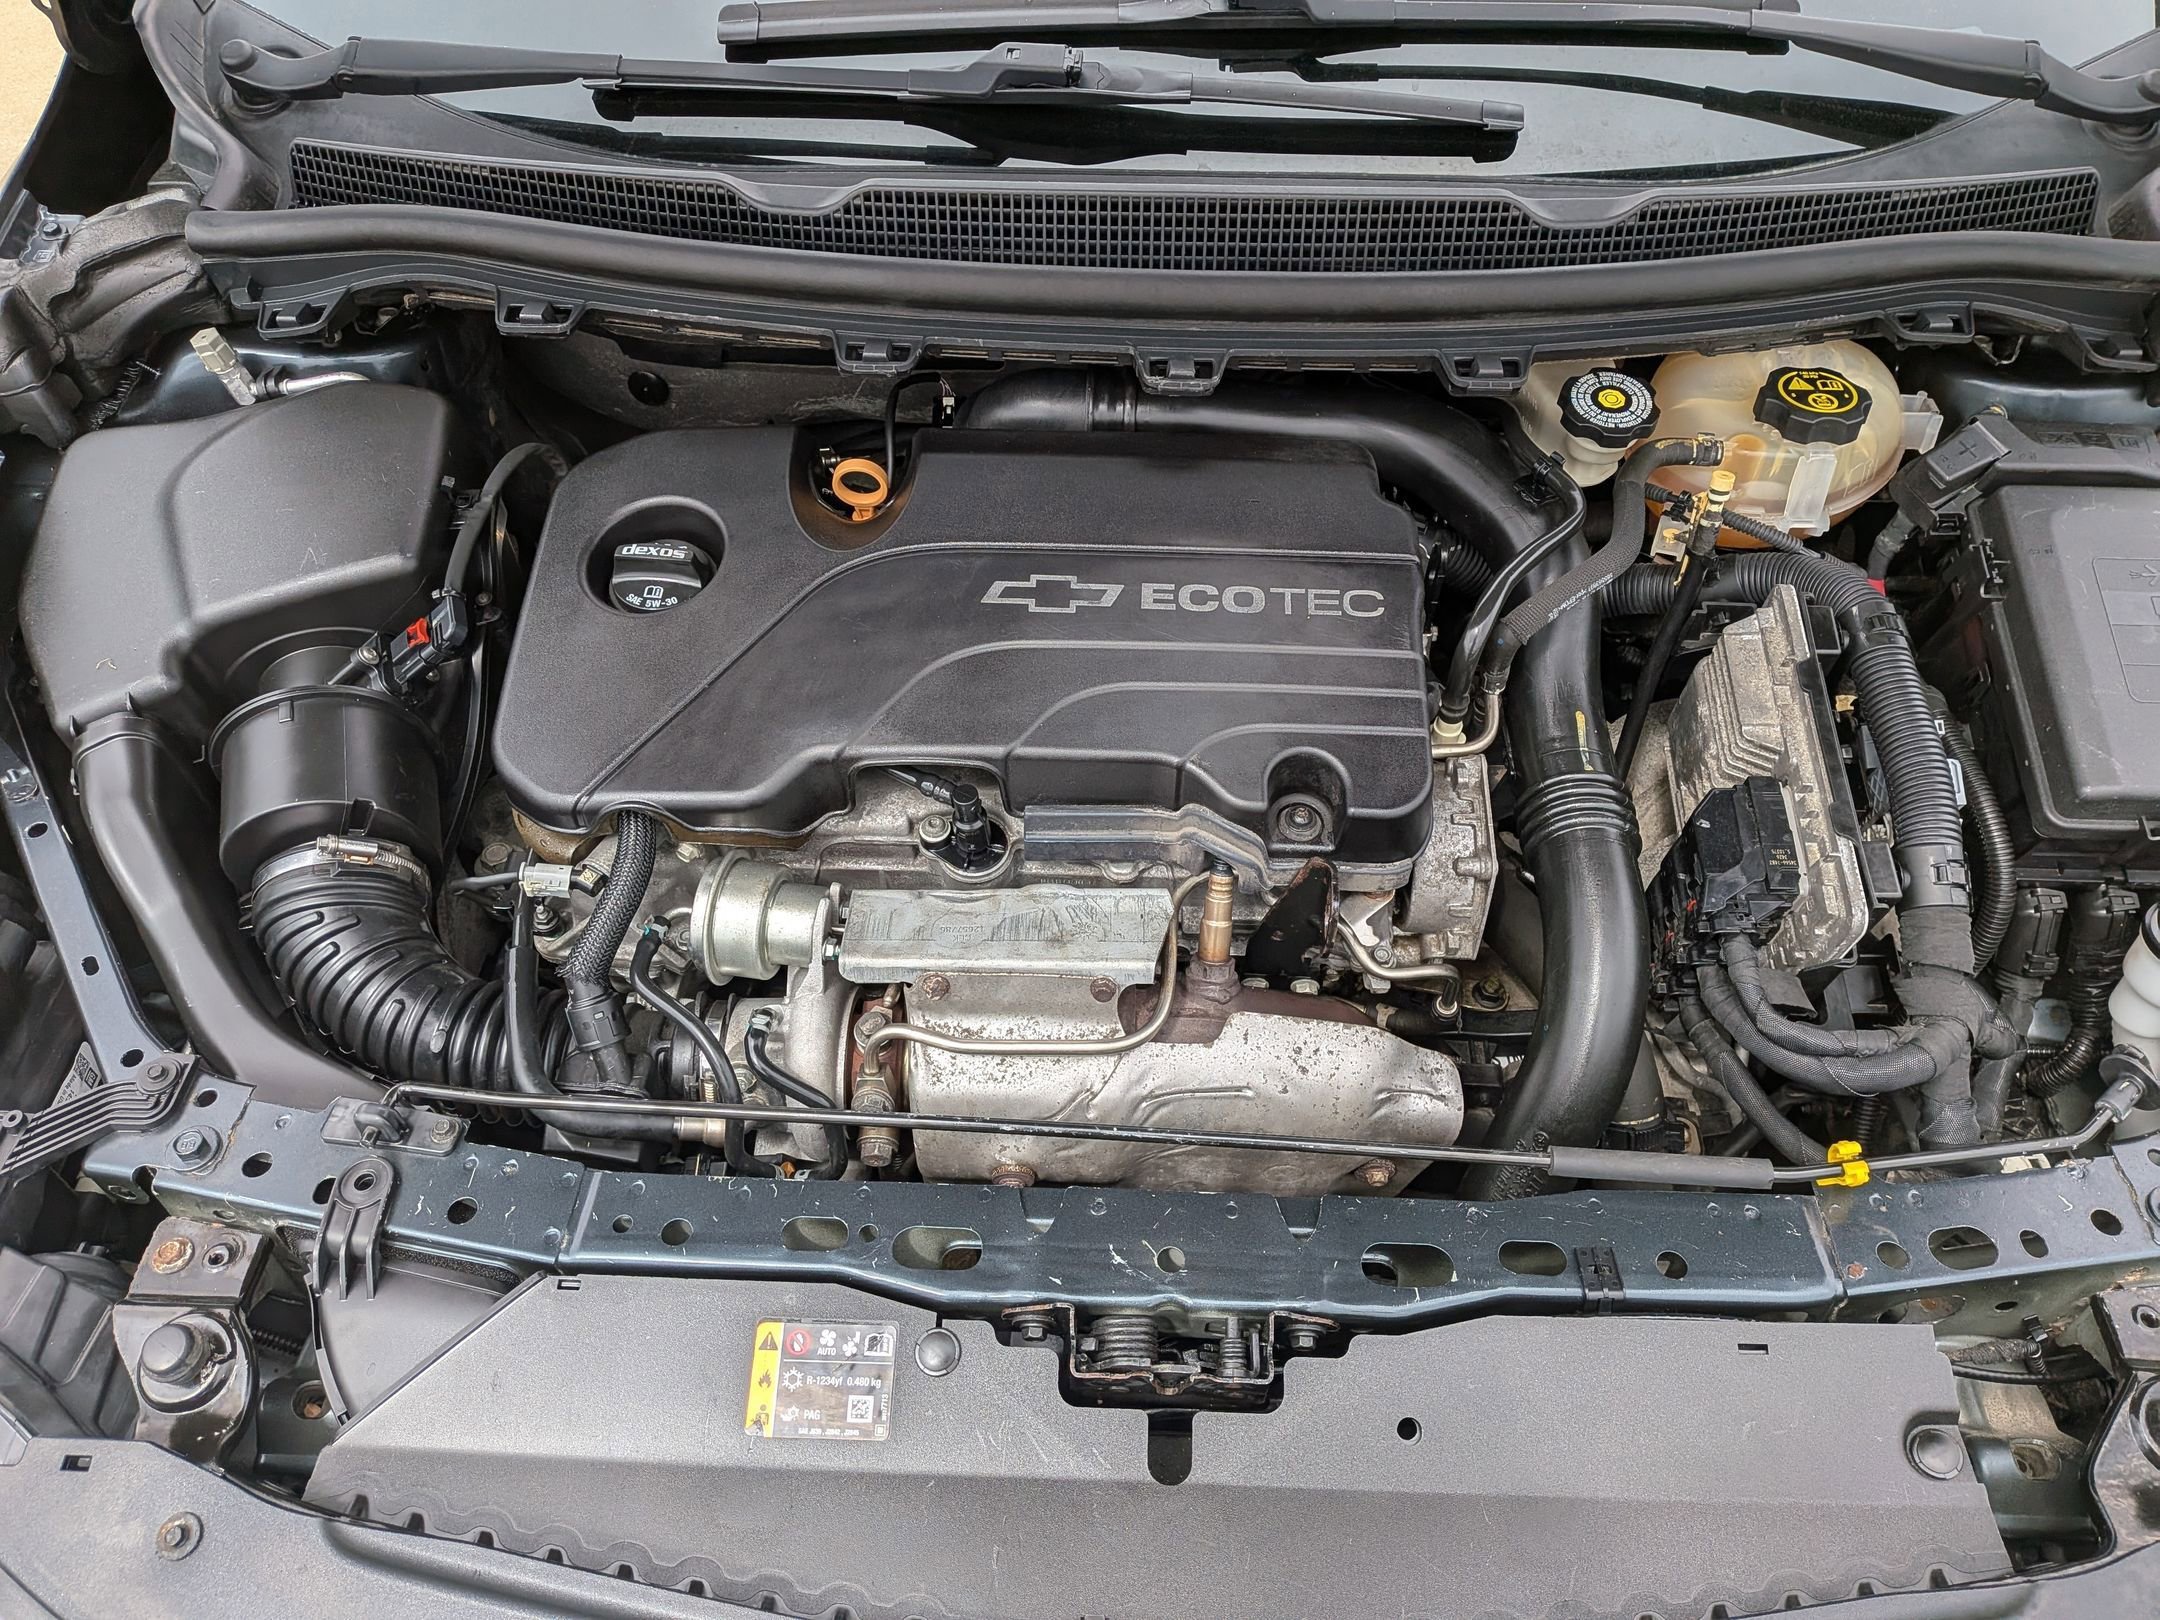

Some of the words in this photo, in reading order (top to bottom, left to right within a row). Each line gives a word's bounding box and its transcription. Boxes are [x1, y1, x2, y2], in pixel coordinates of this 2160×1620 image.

[622, 544, 688, 559] dexos
[626, 594, 643, 605] SAE
[645, 596, 678, 608] 5W-30
[1140, 582, 1385, 618] ECOTEC
[817, 1347, 836, 1356] AUTO
[806, 1376, 842, 1388] R-1234yf
[871, 1378, 882, 1389] kg
[804, 1410, 820, 1420] PAG
